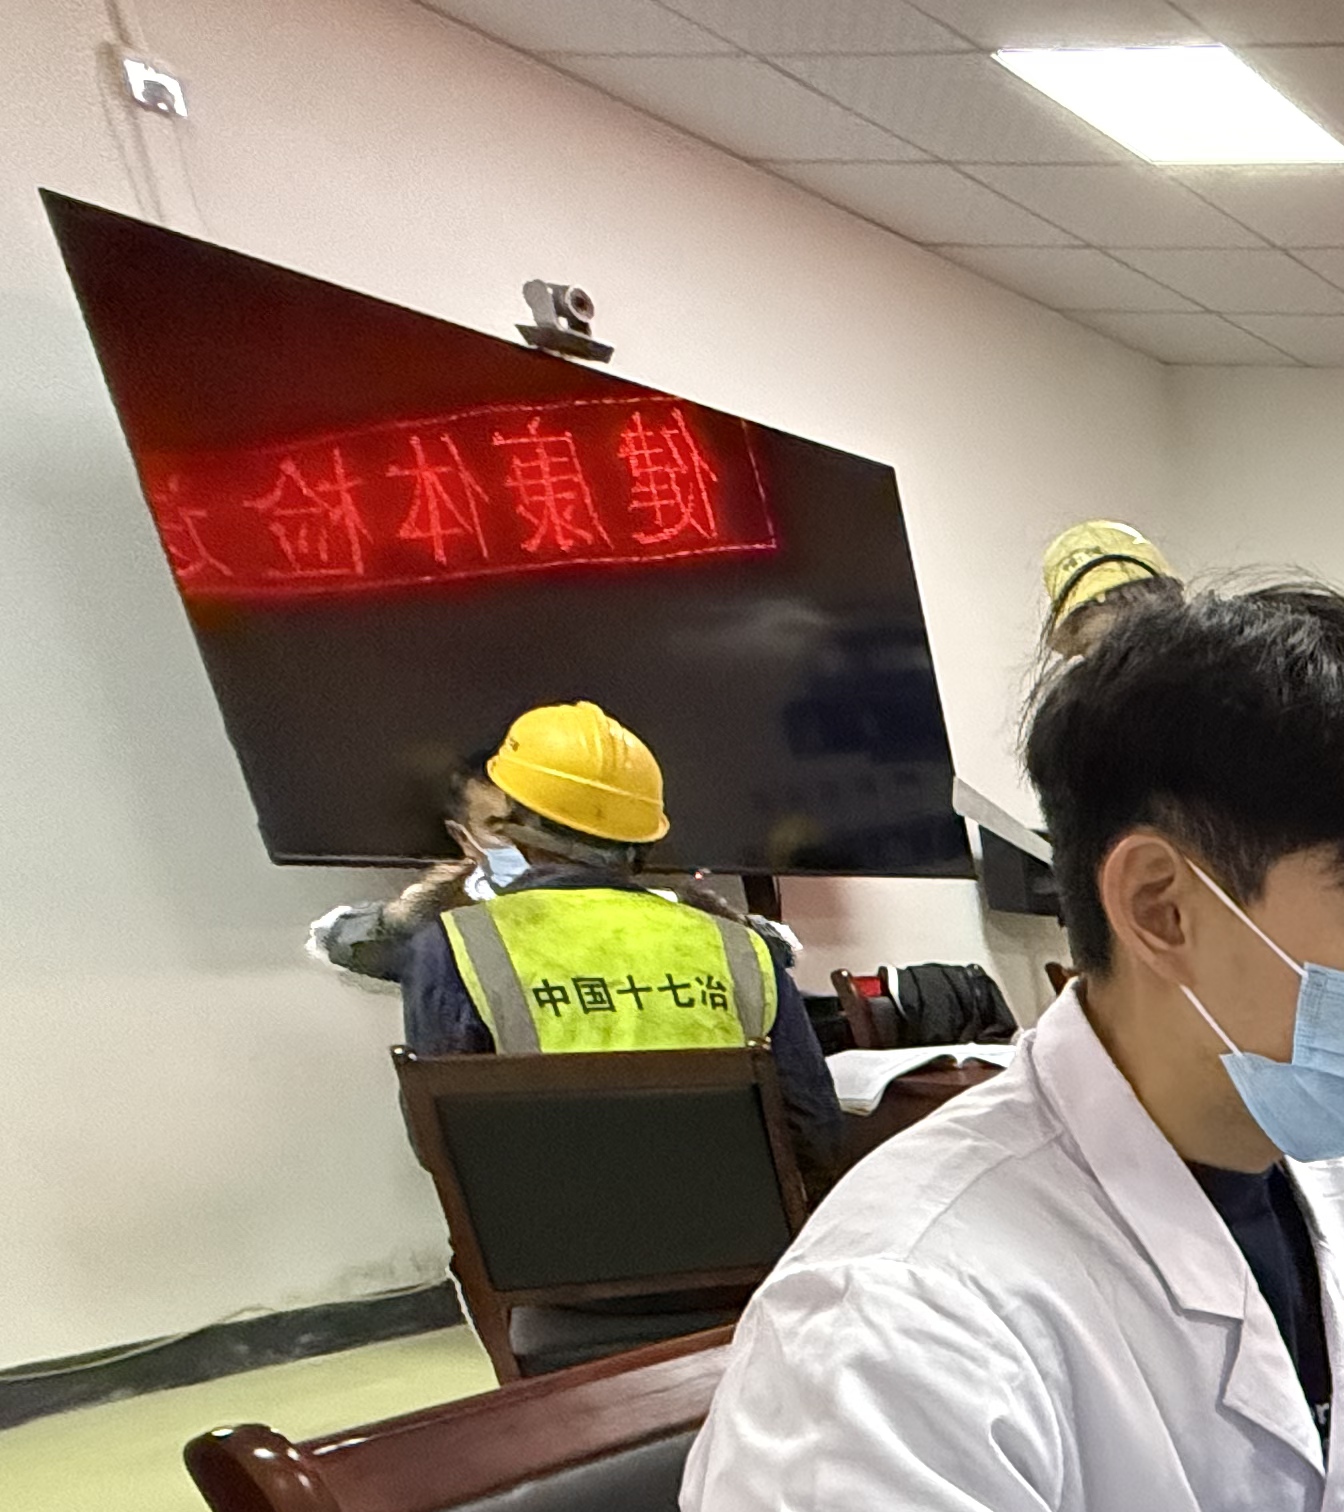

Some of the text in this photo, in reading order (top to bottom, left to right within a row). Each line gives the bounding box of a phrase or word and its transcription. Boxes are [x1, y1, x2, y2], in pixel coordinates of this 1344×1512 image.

[533, 973, 729, 1018] 中国十七冶
